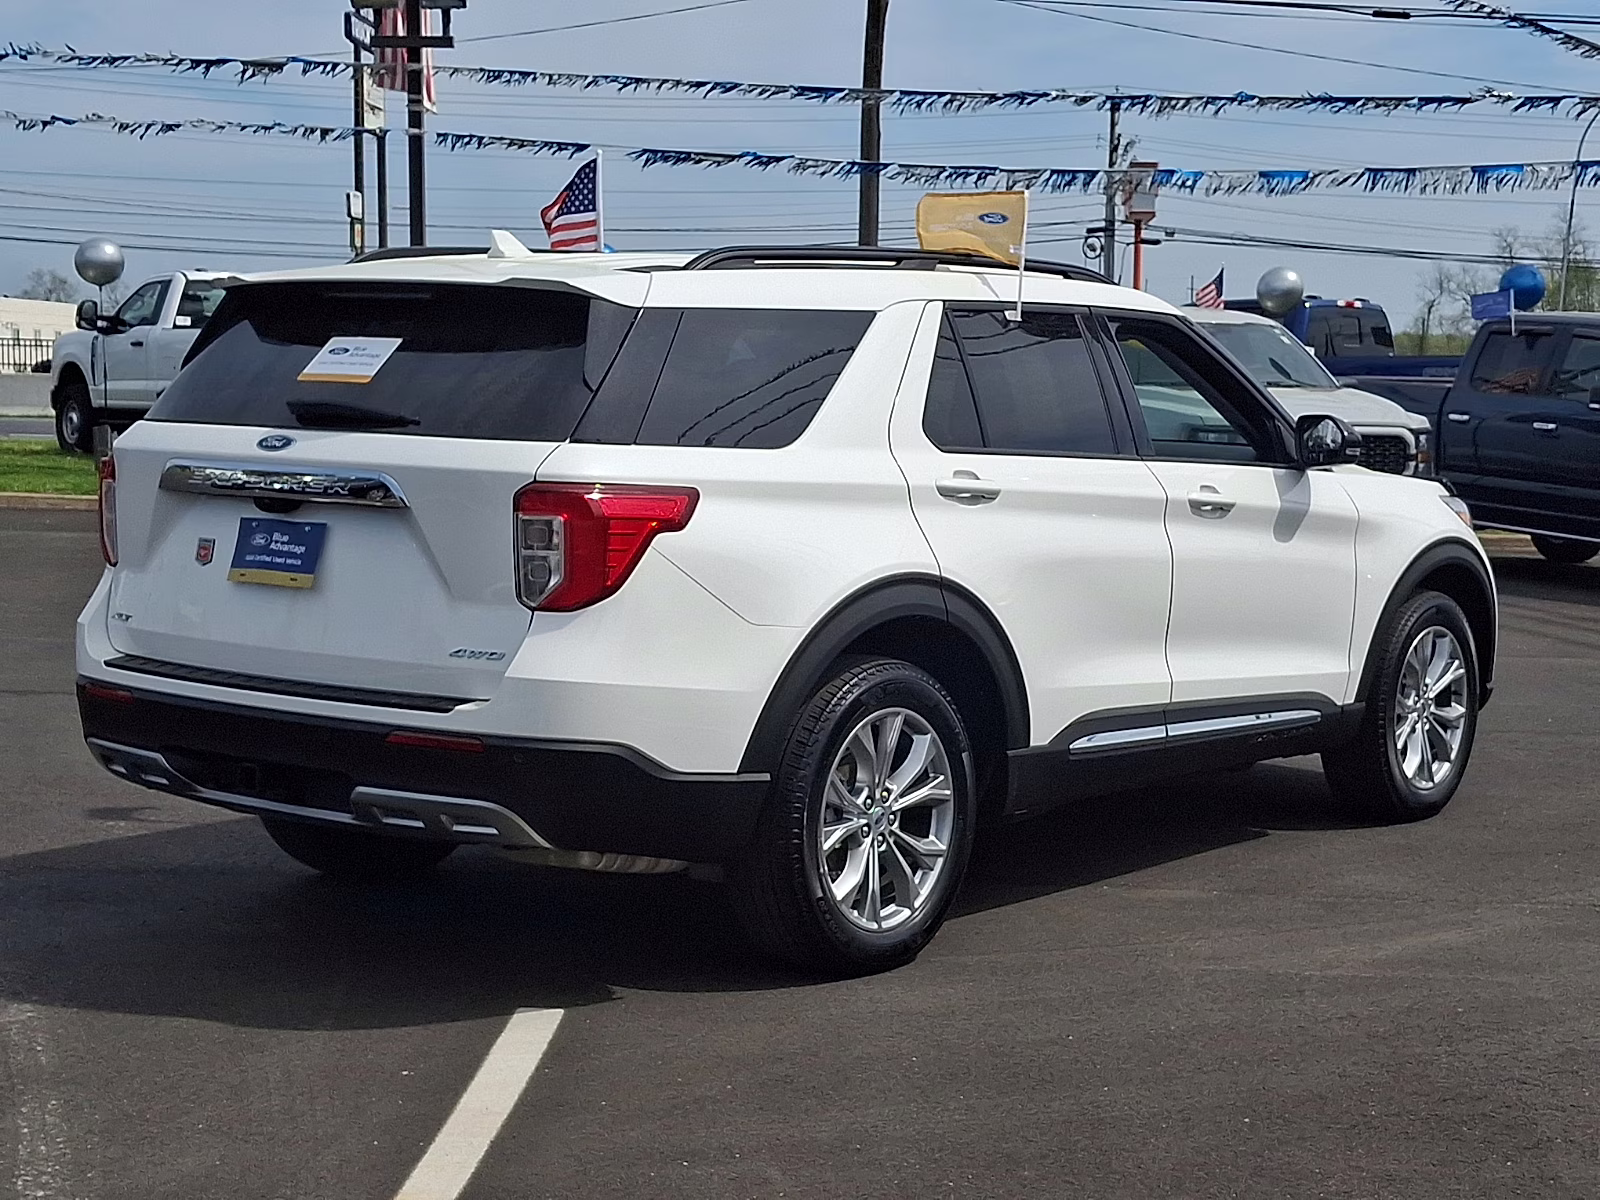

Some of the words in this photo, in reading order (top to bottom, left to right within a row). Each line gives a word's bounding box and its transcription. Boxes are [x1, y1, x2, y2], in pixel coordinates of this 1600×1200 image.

[259, 435, 292, 450] Ford
[188, 466, 350, 495] EXPLORER
[272, 532, 289, 542] Blue
[269, 541, 306, 554] Advantage
[449, 647, 506, 661] 4WD
